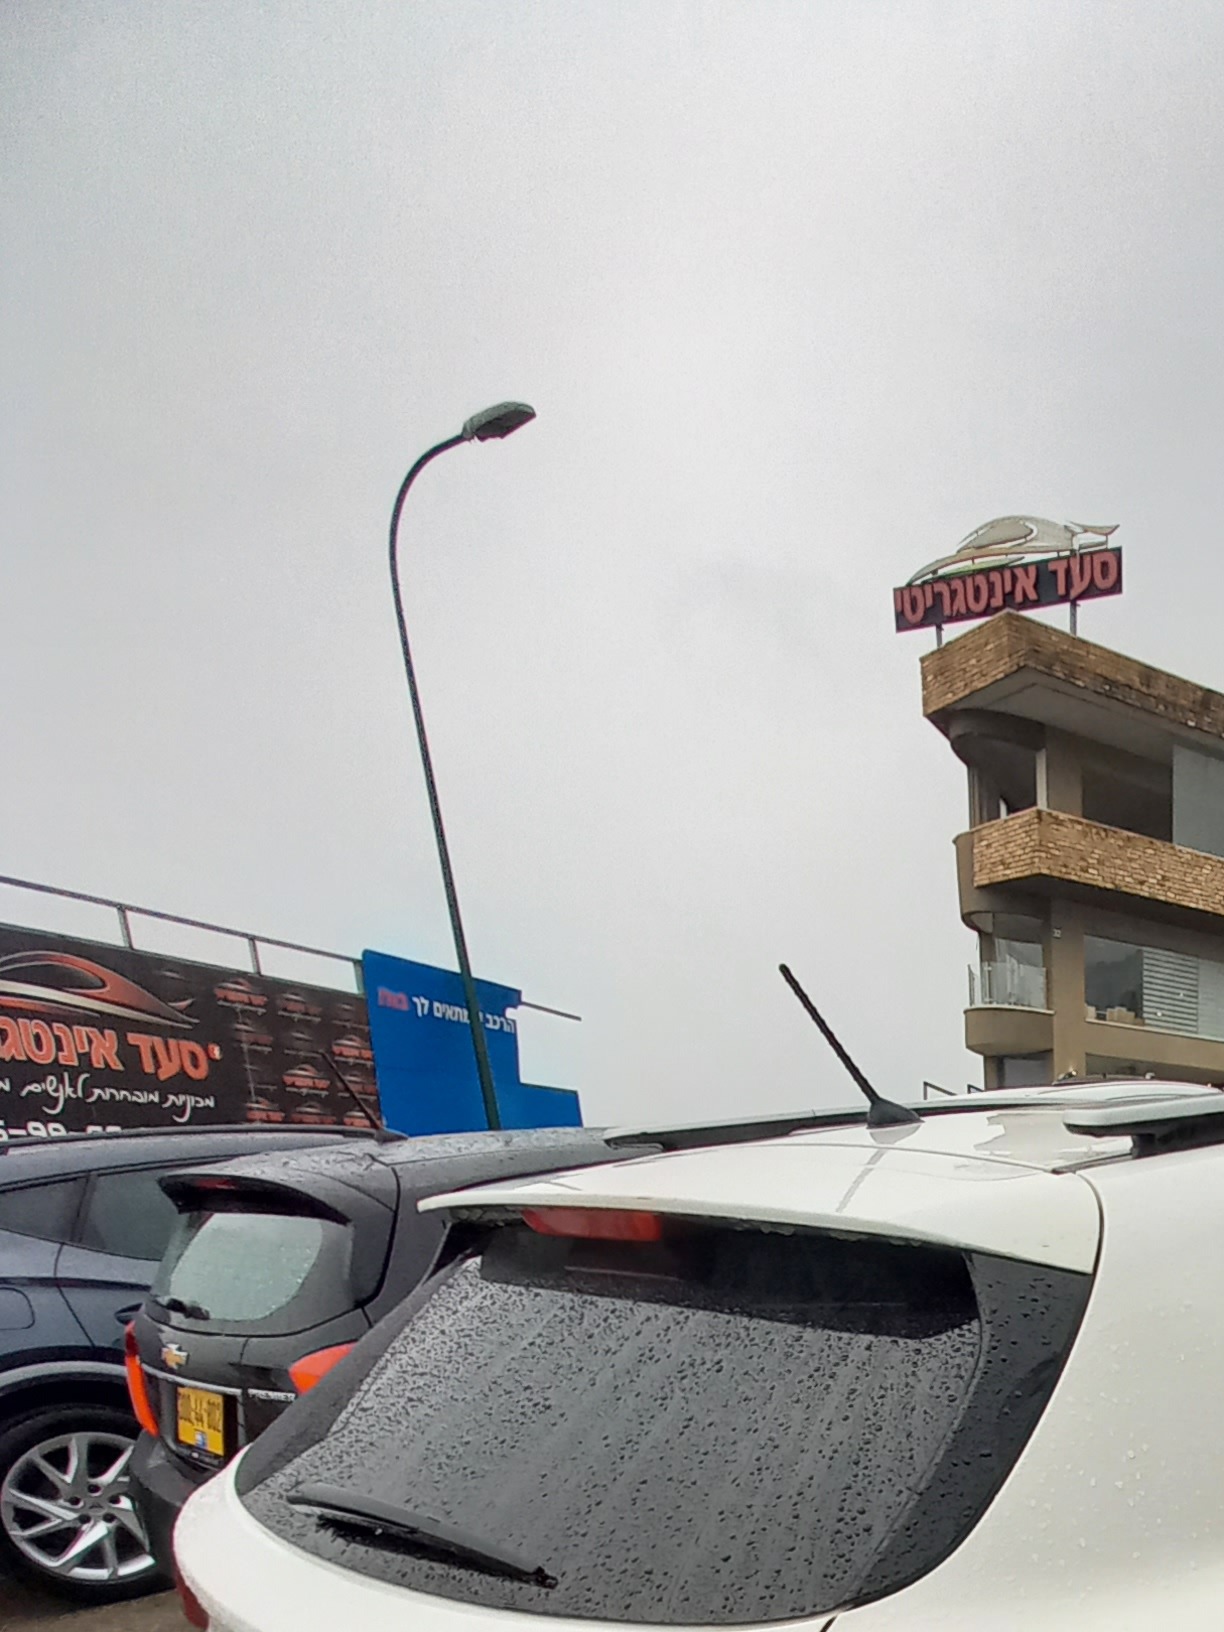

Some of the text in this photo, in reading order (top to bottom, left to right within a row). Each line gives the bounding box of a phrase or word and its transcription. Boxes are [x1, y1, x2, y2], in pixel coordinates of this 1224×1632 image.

[895, 552, 1118, 624] סעד אינטגריטי
[412, 996, 430, 1017] לך
[486, 1013, 515, 1033] הרכב
[126, 1032, 209, 1081] סעד
